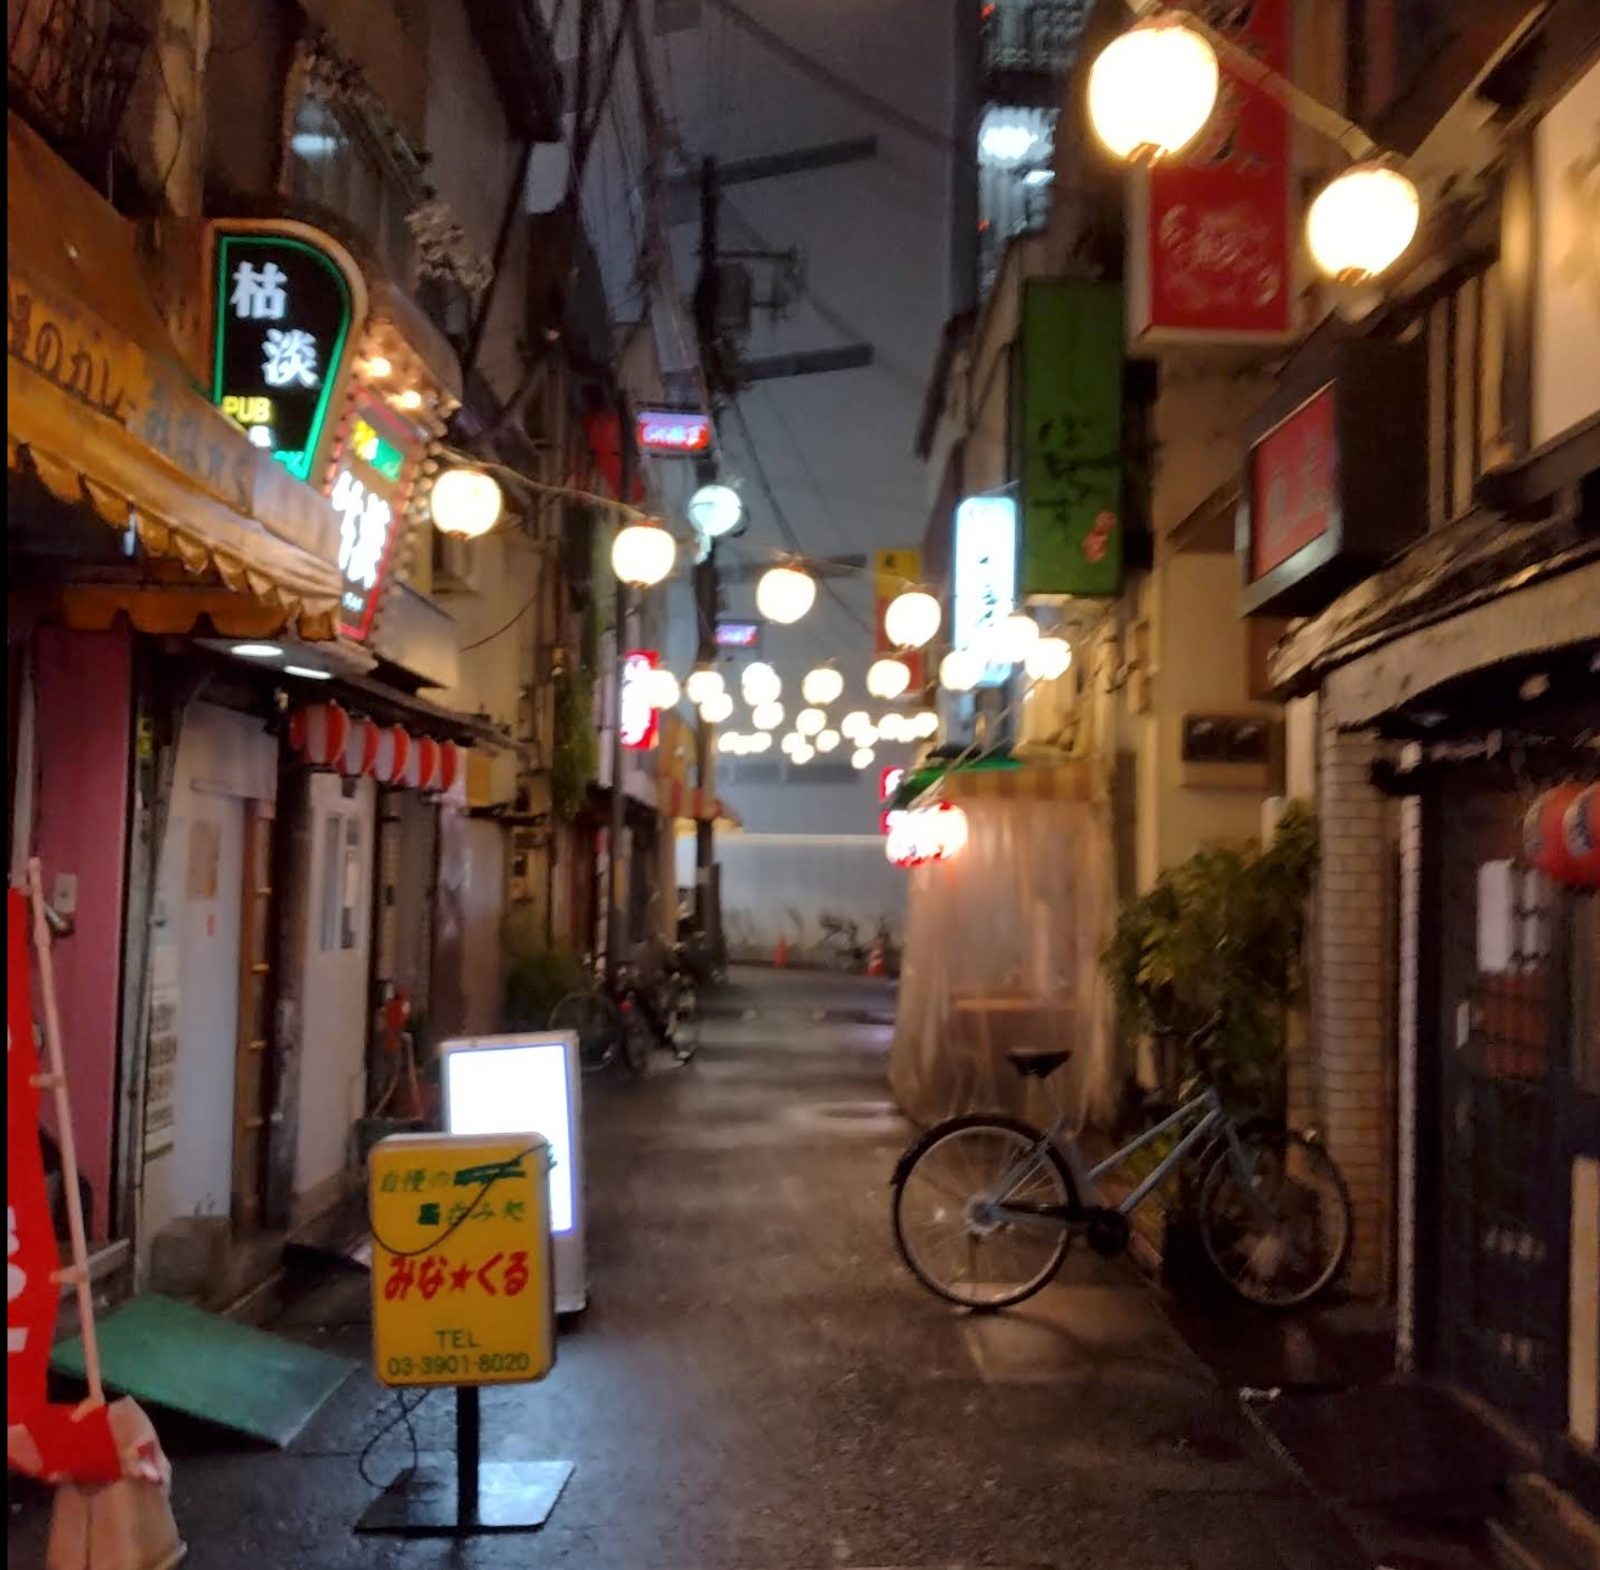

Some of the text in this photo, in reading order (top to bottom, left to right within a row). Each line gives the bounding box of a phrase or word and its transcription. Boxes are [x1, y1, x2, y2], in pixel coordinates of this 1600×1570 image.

[230, 260, 319, 388] 枯淡
[222, 396, 272, 423] PUB
[435, 1330, 481, 1349] TEL
